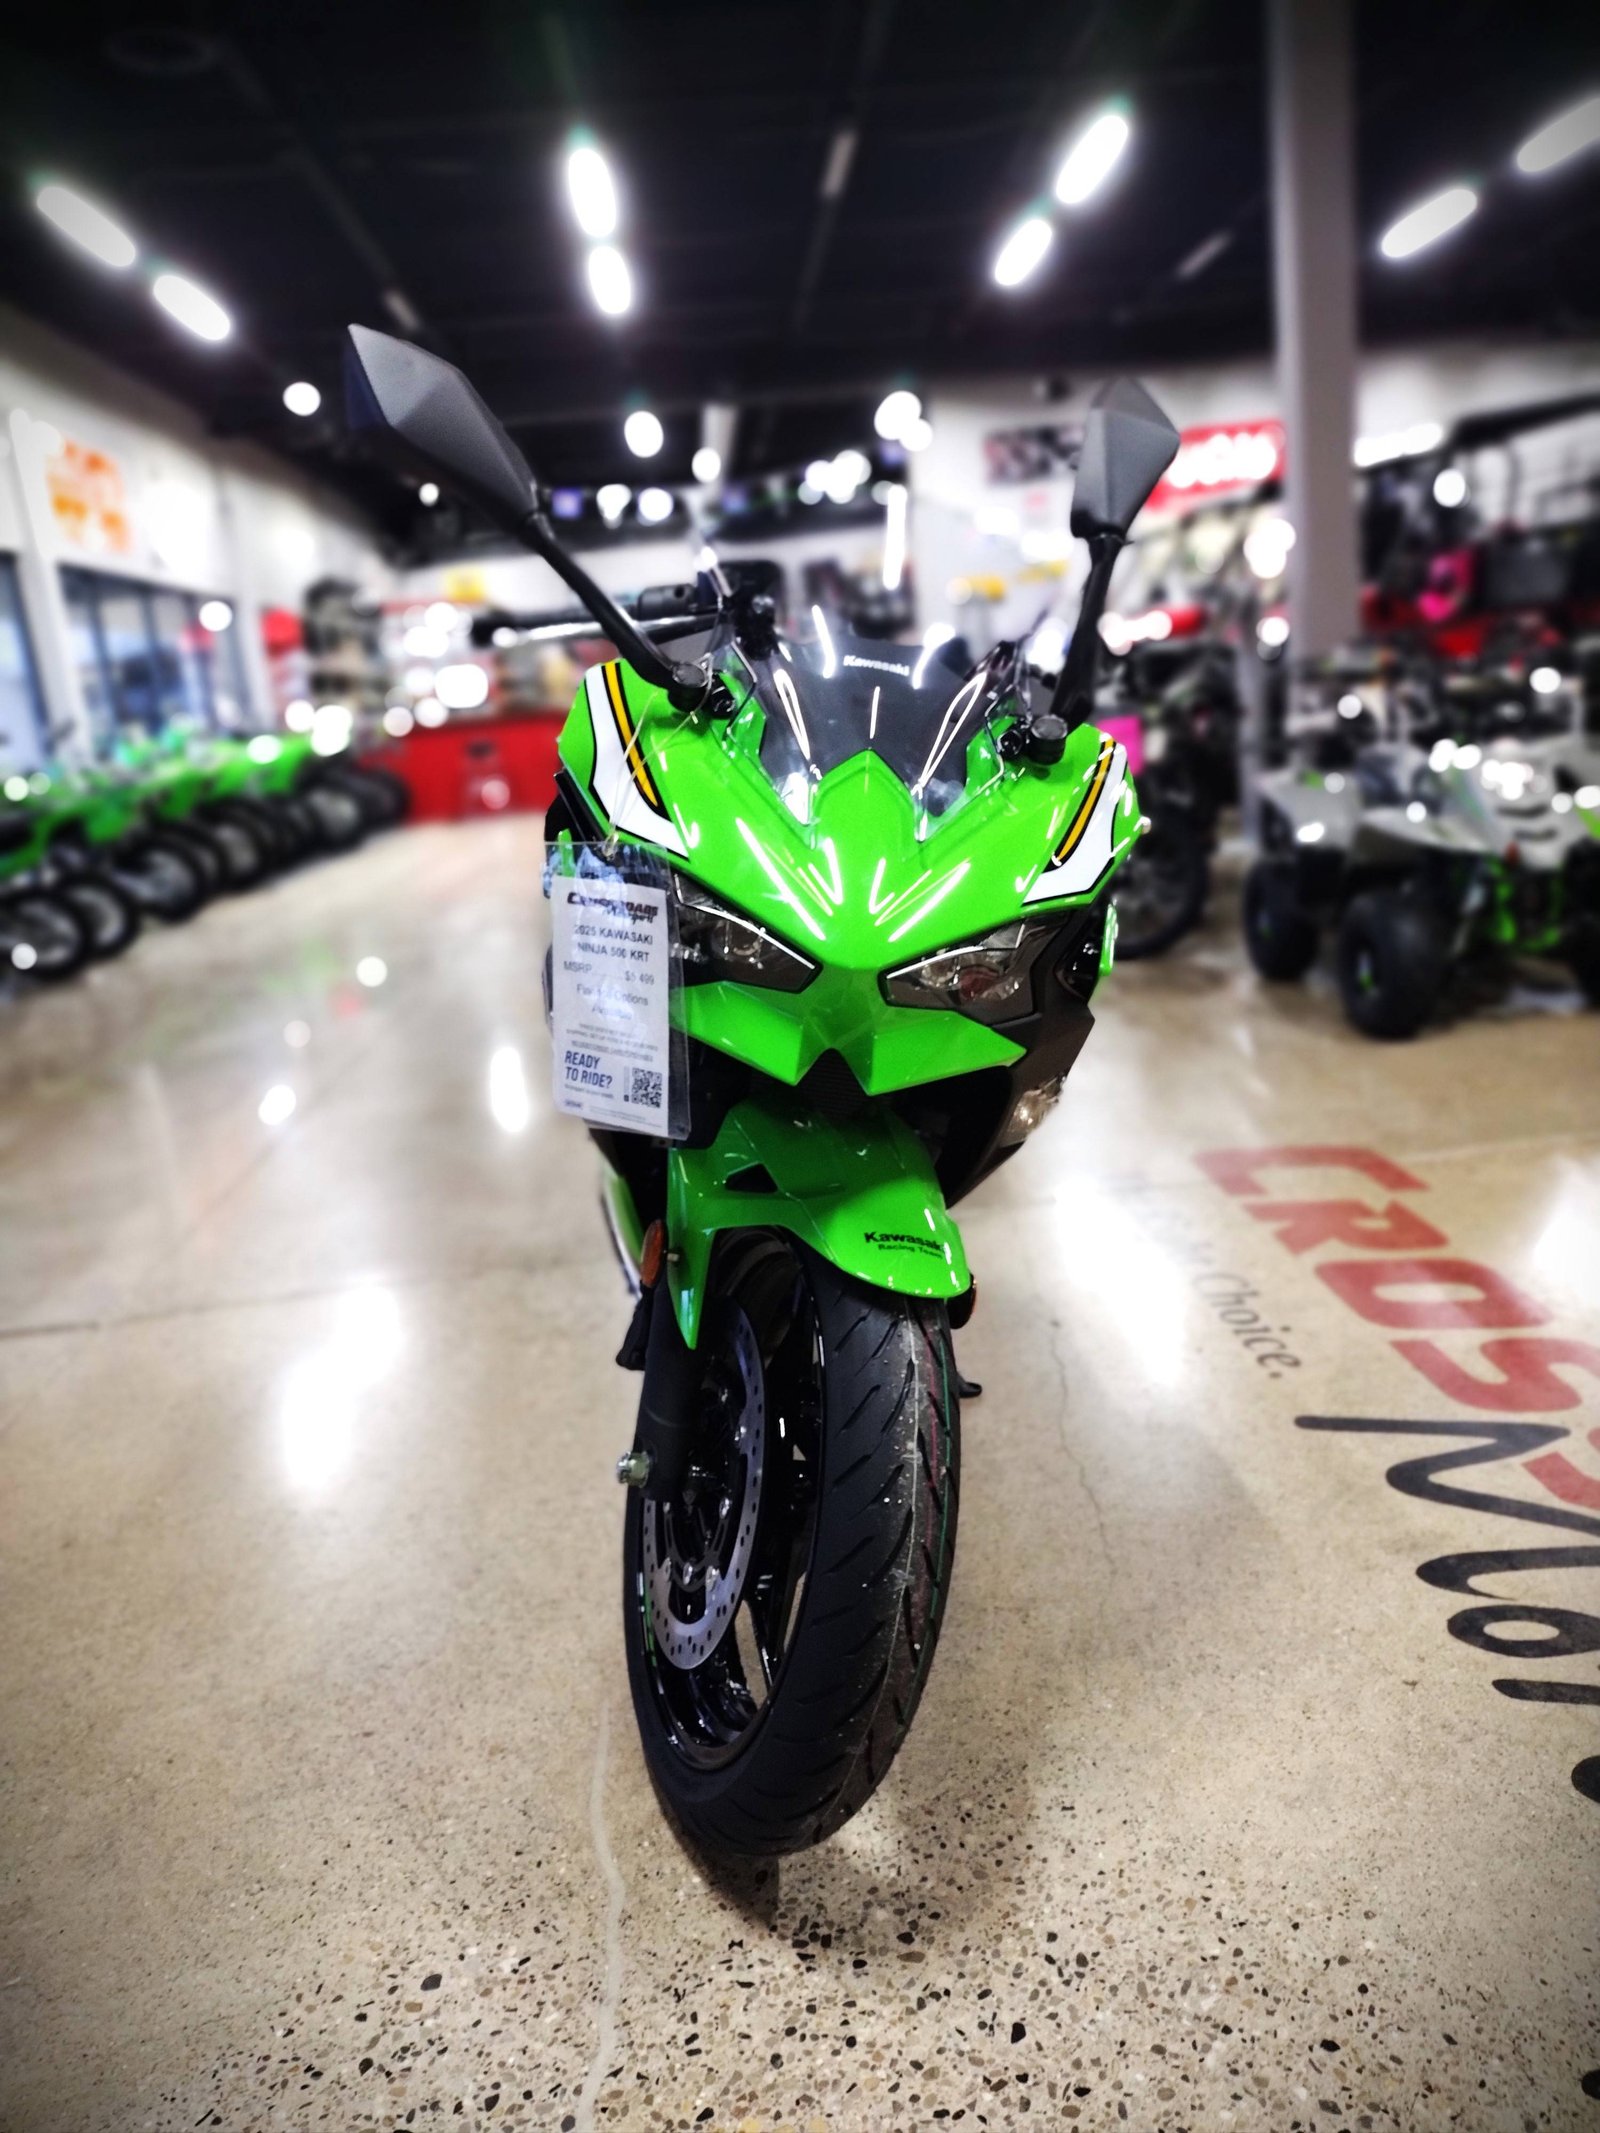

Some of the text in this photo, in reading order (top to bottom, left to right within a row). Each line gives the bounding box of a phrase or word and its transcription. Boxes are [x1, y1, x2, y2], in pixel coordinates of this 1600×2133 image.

[843, 654, 909, 676] Kawasaki
[600, 927, 653, 945] KAWASAKI
[577, 941, 608, 955] NINJA
[630, 949, 650, 963] KRT
[563, 960, 593, 974] MSRP
[564, 1050, 601, 1069] READY
[565, 1066, 614, 1089] TO RIDE?
